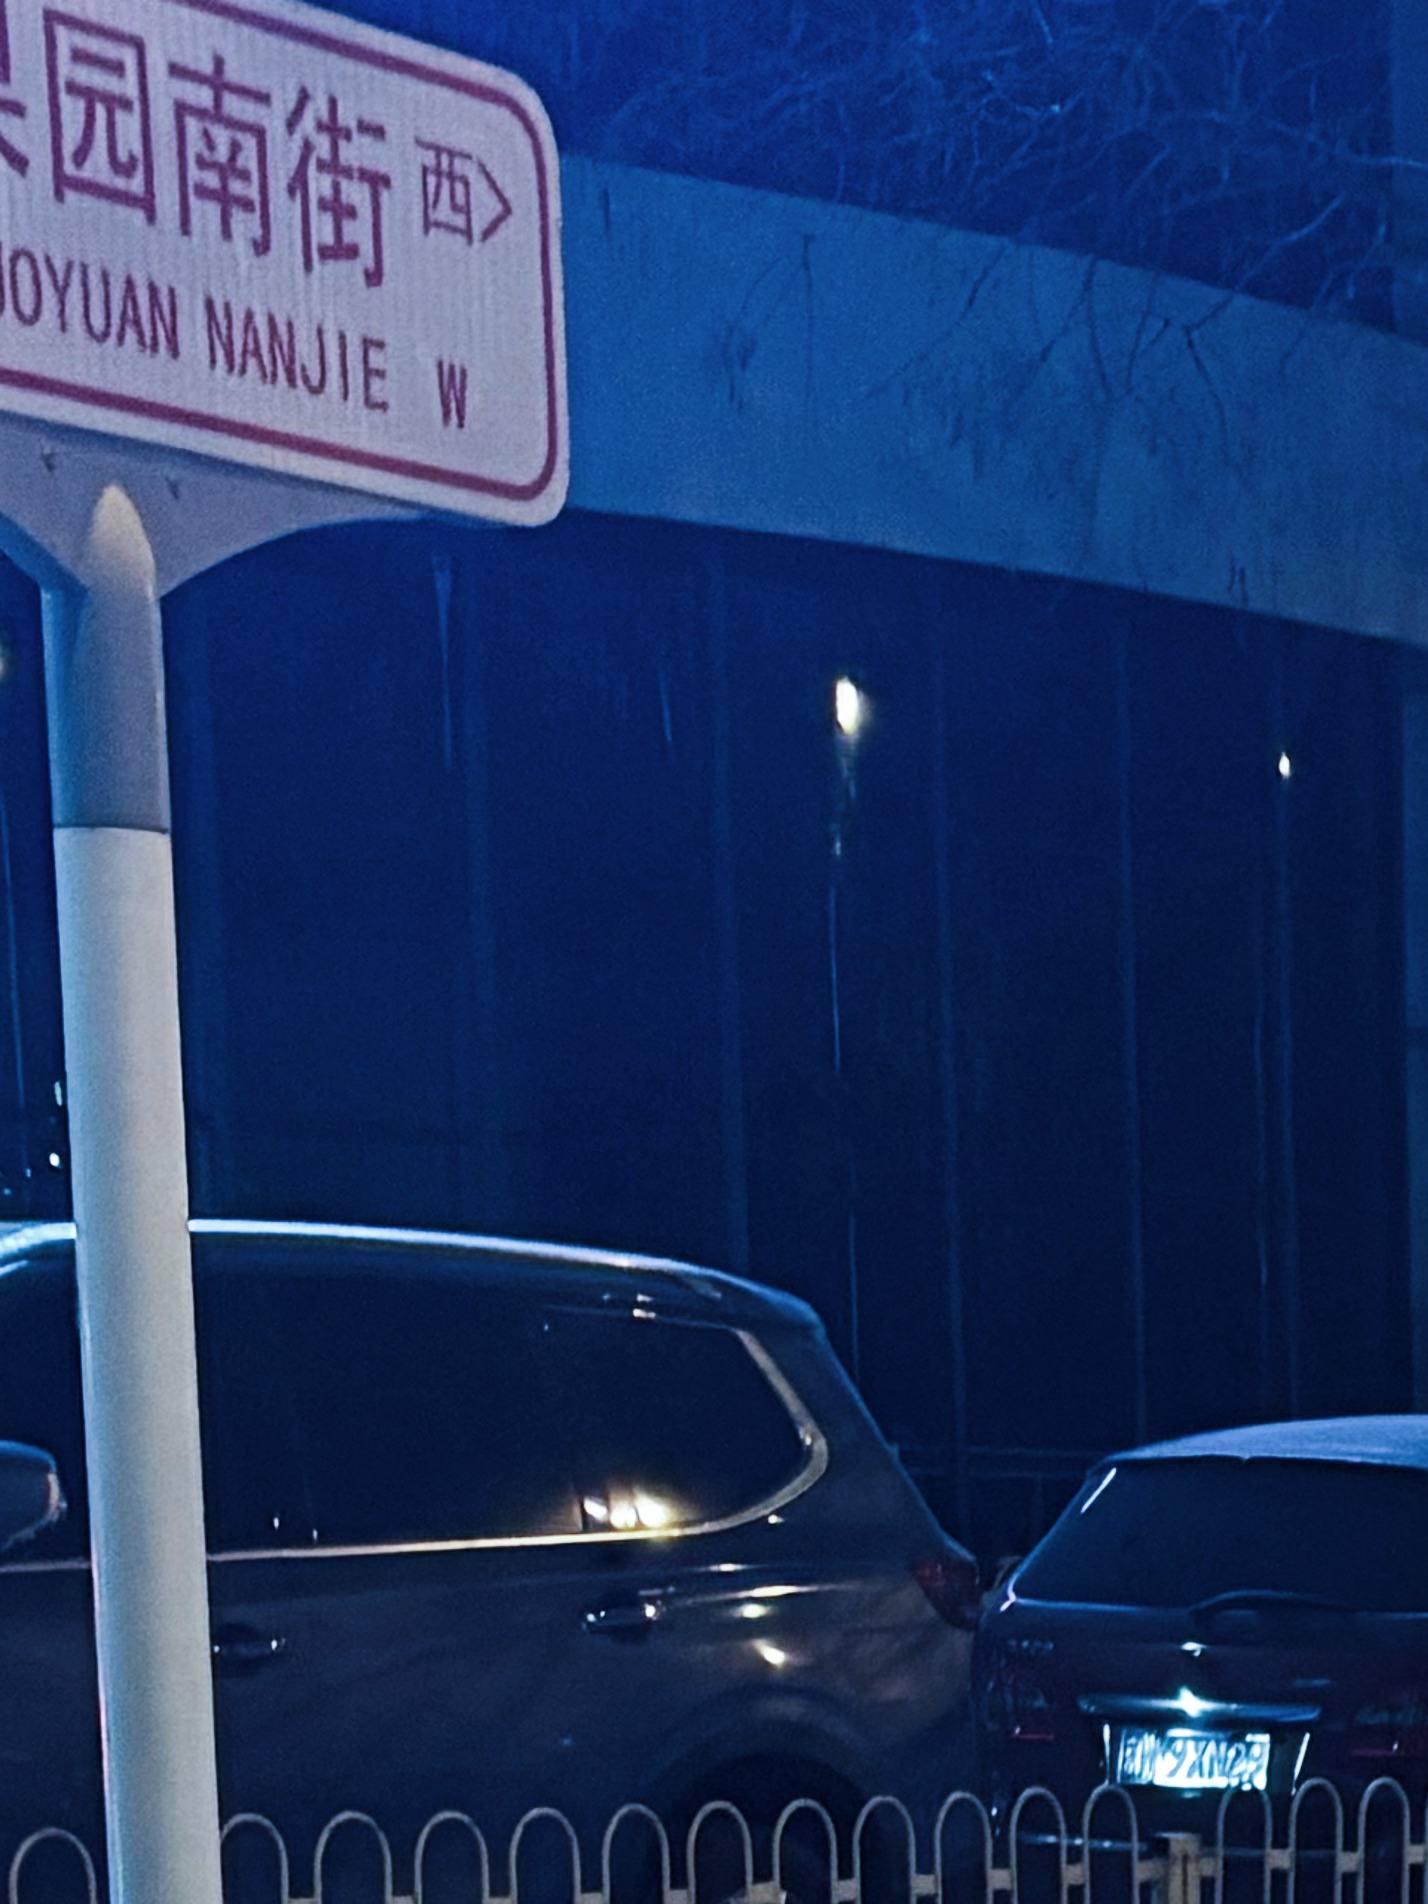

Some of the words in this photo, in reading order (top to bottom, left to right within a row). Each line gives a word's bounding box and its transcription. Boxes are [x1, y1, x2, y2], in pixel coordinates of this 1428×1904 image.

[414, 135, 474, 247] 西
[0, 245, 180, 361] OYUAN
[205, 296, 390, 413] NANJIE
[437, 358, 468, 430] W
